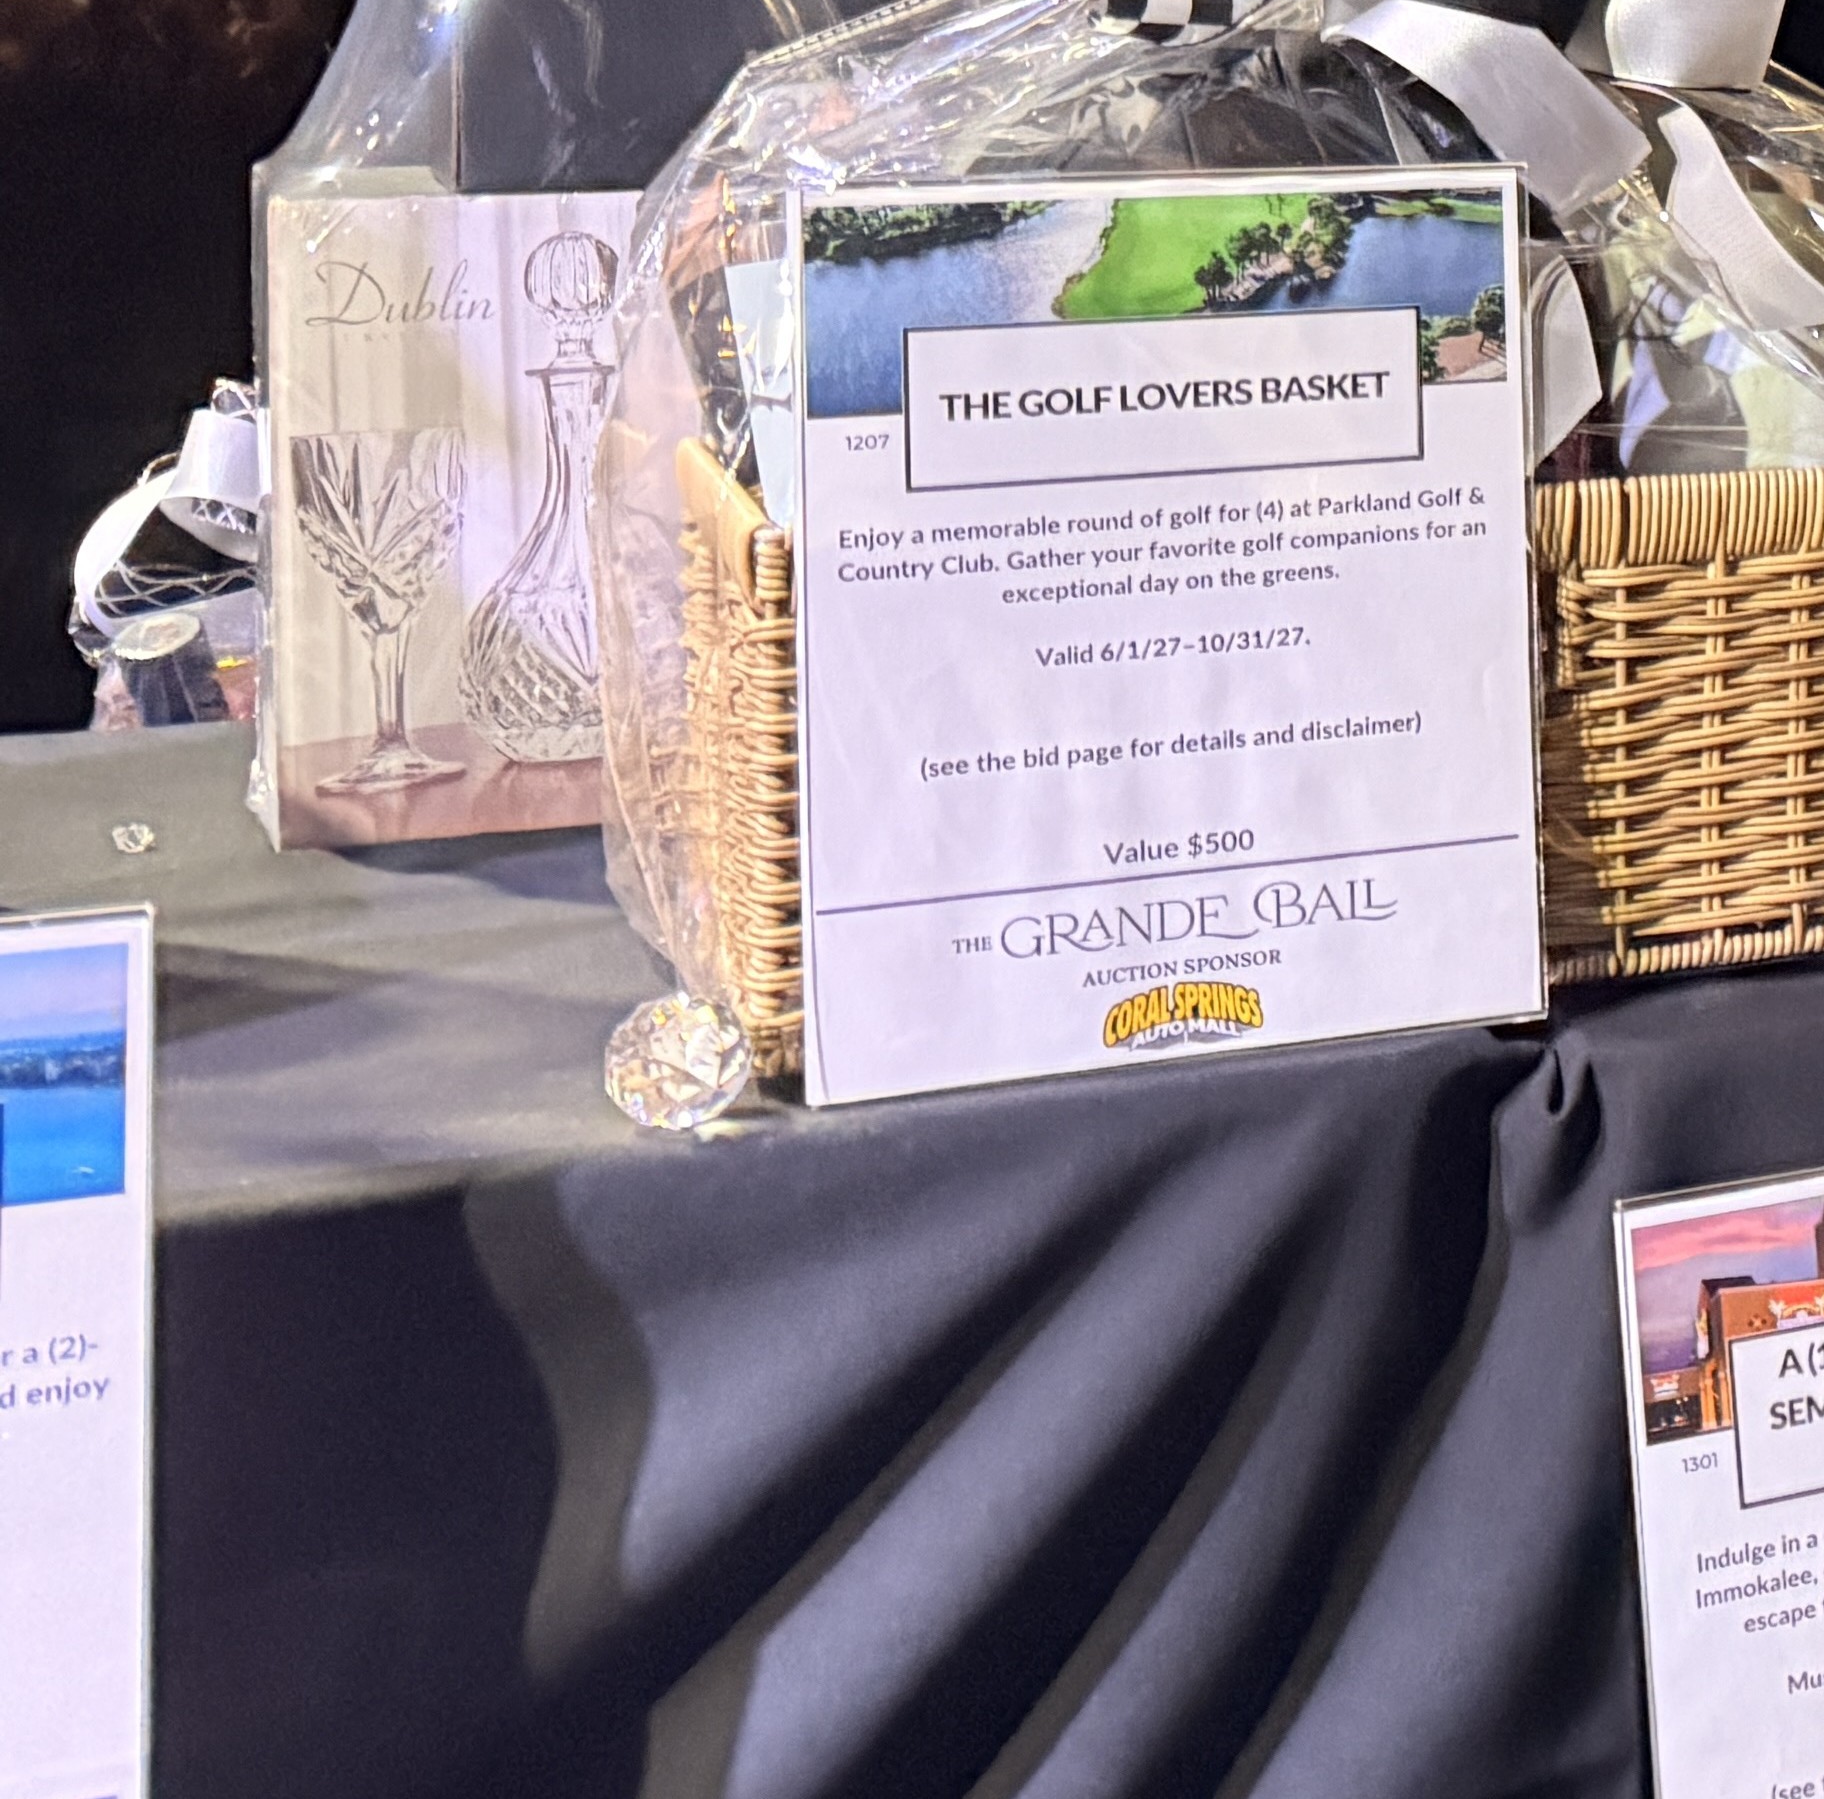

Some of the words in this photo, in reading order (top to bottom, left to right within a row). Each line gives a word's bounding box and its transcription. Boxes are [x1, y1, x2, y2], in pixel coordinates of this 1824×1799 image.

[305, 257, 494, 328] Dublin
[938, 391, 1012, 421] THE
[1018, 385, 1113, 417] GOLF
[1119, 378, 1253, 412] LOVERS
[1260, 370, 1390, 404] BASKET
[845, 433, 890, 451] 1207
[839, 527, 904, 552] Enjoy
[910, 529, 924, 544] a
[931, 514, 1060, 543] memorable
[1067, 509, 1133, 534] round
[1139, 507, 1163, 528] of
[1169, 504, 1212, 530] golf
[1218, 503, 1250, 523] for
[1255, 499, 1284, 524] (4)
[1289, 498, 1311, 518] at
[1318, 490, 1411, 516] Parkland
[1417, 487, 1462, 508] Golf
[1468, 486, 1485, 505] &
[1034, 642, 1093, 667] Valid
[1103, 838, 1179, 865] Value
[1187, 828, 1254, 859] $500
[952, 935, 993, 955] THE
[1000, 893, 1260, 959] GRANDE
[1252, 877, 1399, 929] BALL
[1082, 960, 1178, 988] AUCTION
[1183, 948, 1282, 975] SPONSOR
[1102, 984, 1173, 1049] CORAL
[1173, 980, 1264, 1029] SPRINGS
[1132, 1018, 1184, 1050] AUTO
[1184, 1015, 1240, 1044] MALL
[22, 1346, 38, 1365] a
[1778, 1348, 1803, 1378] A
[26, 1376, 110, 1406] enjoy
[1681, 1451, 1718, 1474] 1301
